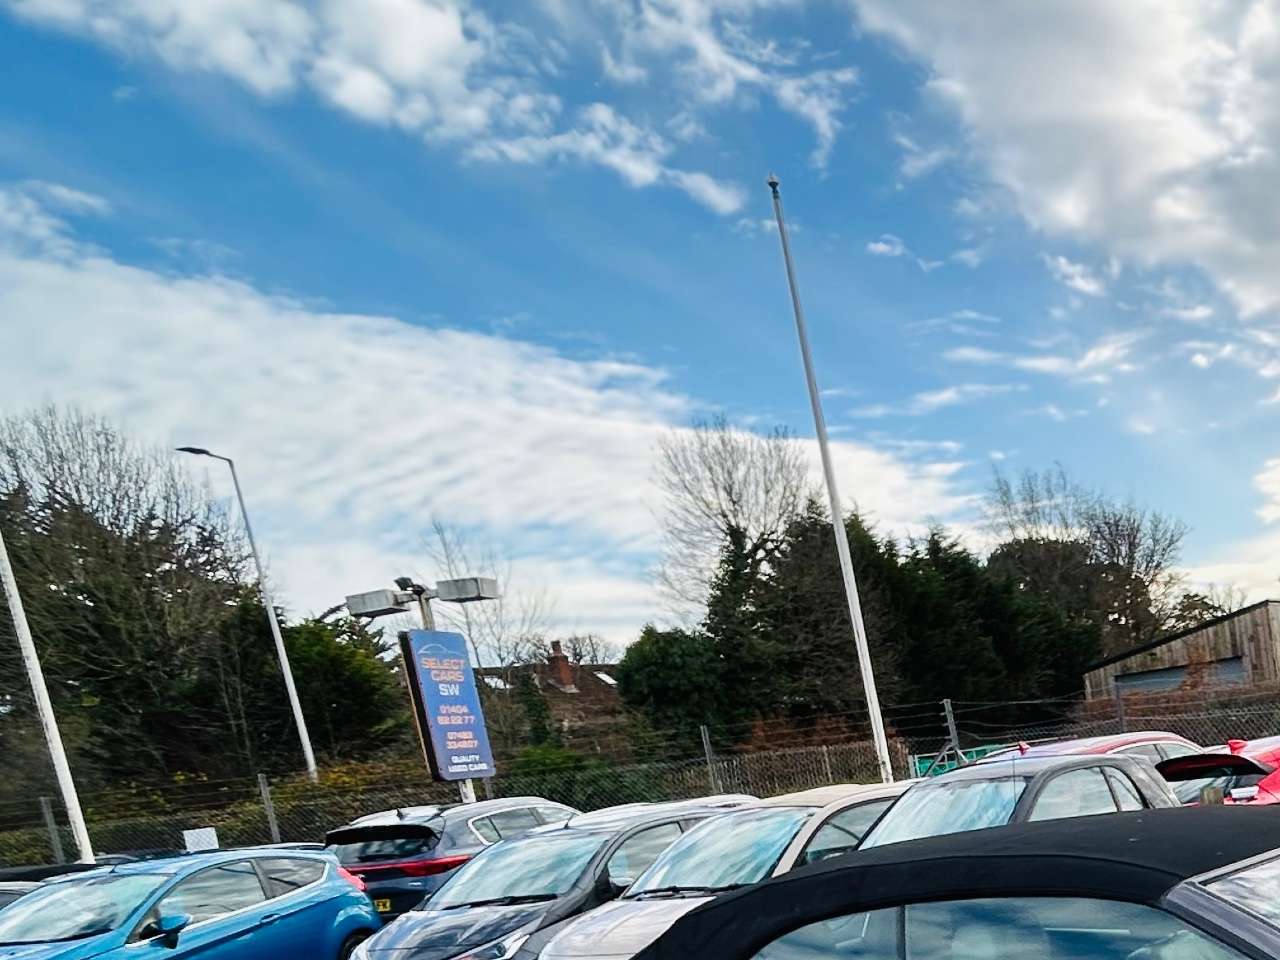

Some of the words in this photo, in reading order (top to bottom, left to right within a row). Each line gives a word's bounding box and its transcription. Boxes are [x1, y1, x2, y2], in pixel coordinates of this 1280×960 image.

[421, 657, 465, 669] SELECT
[431, 670, 465, 682] CARS
[439, 684, 460, 696] SW
